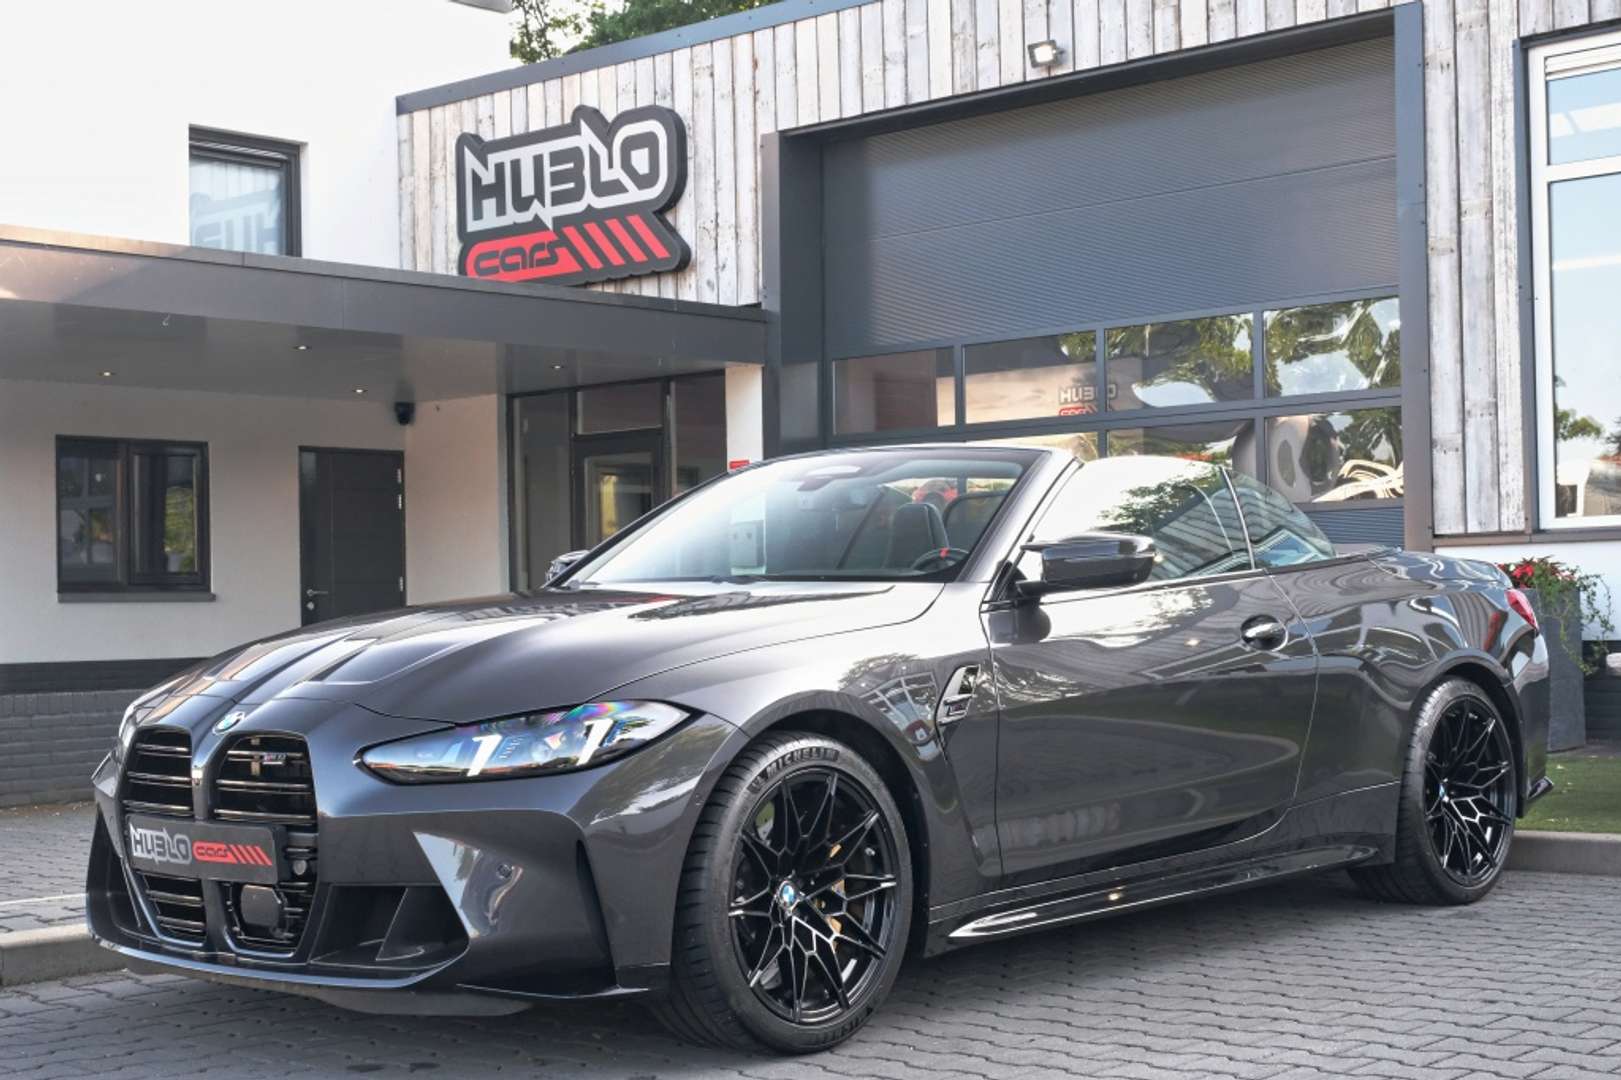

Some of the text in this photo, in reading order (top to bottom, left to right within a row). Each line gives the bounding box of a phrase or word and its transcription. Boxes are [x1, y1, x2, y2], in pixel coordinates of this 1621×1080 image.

[464, 118, 668, 232] HUBLO
[472, 239, 563, 279] cars
[765, 747, 839, 776] MICHELIN
[129, 822, 192, 865] HUBLO
